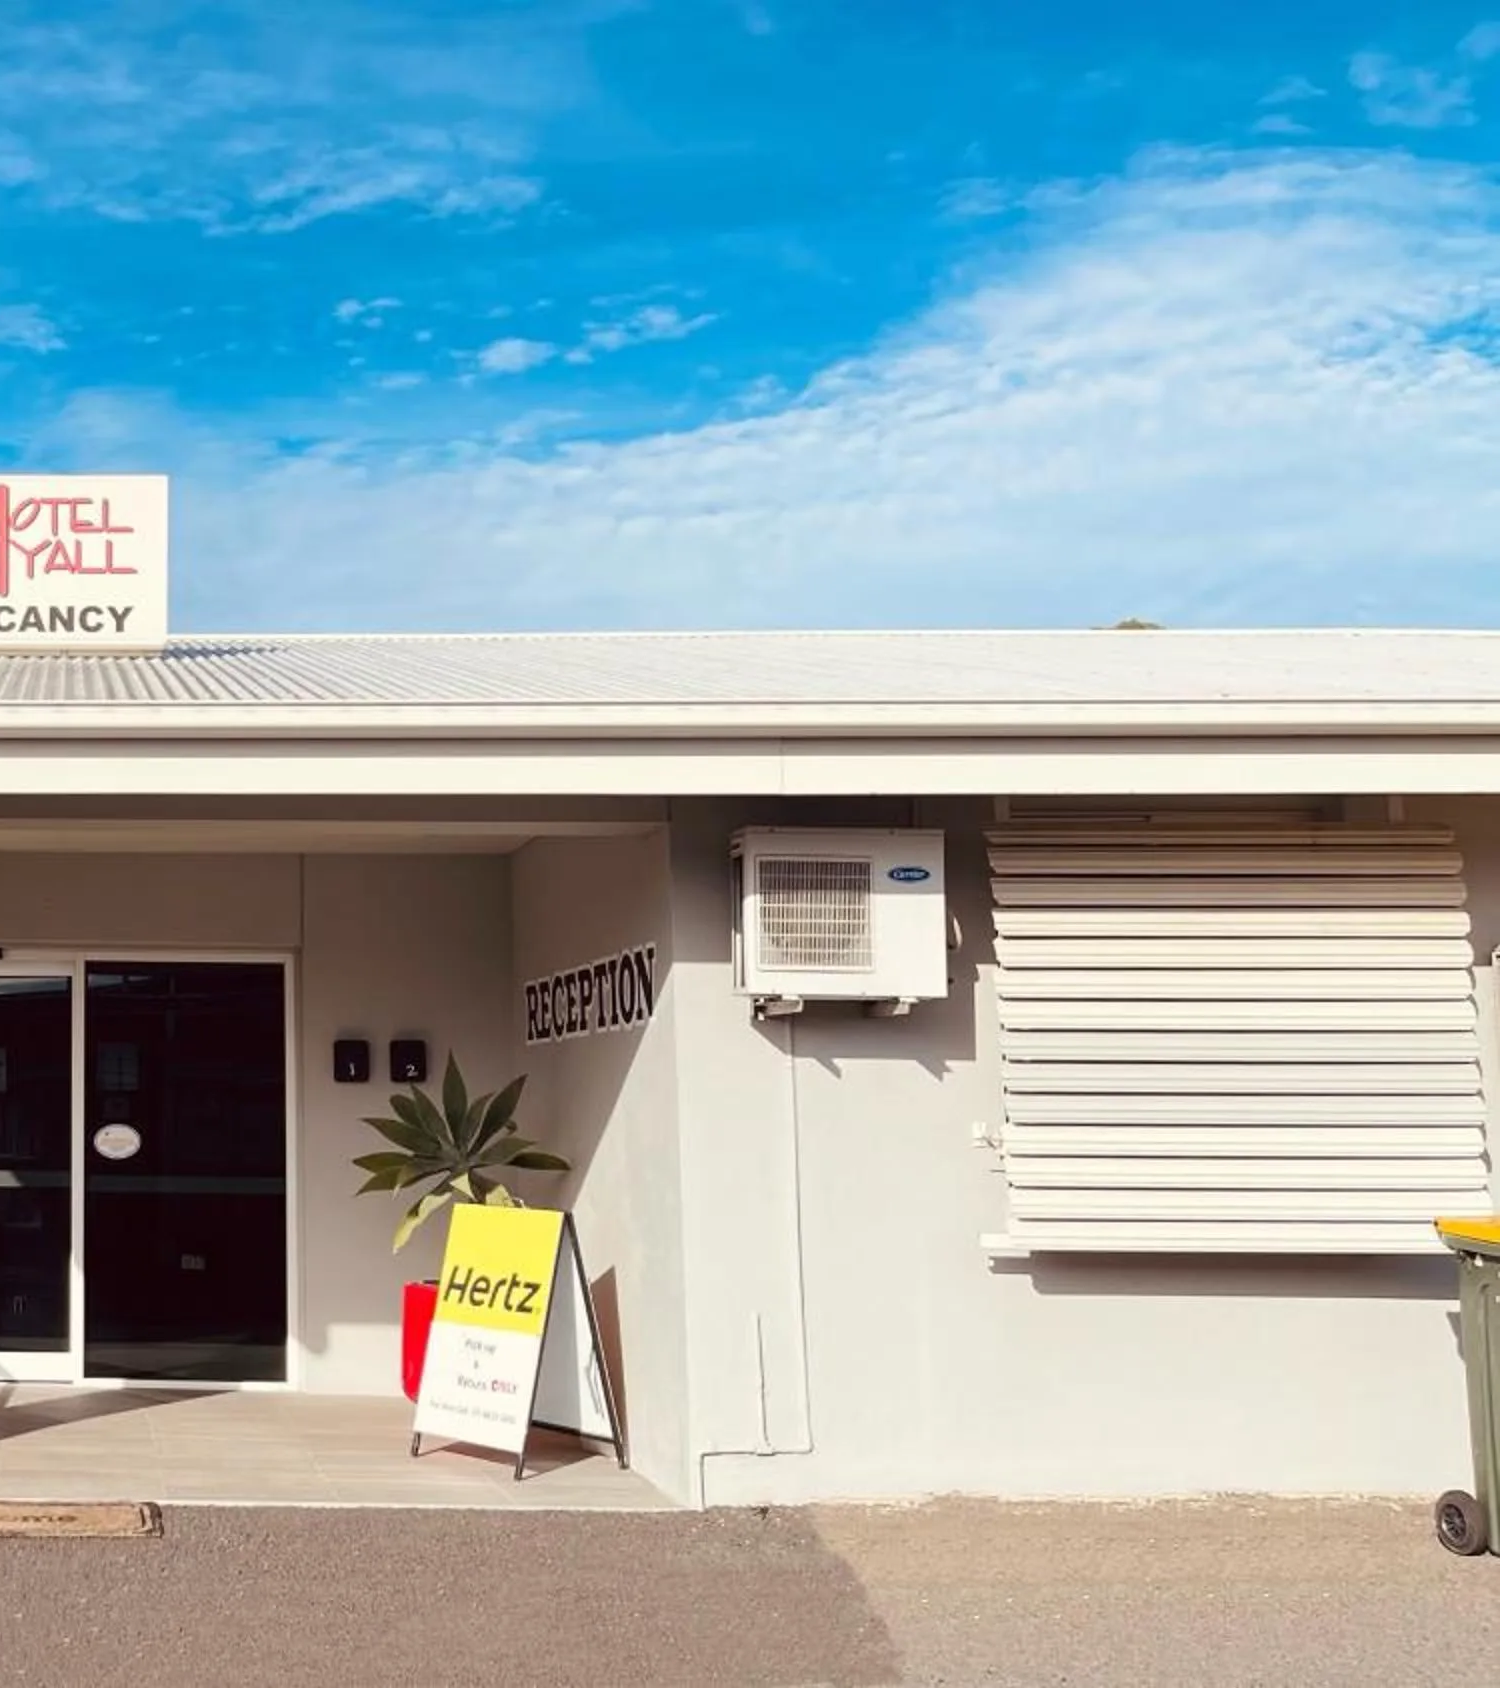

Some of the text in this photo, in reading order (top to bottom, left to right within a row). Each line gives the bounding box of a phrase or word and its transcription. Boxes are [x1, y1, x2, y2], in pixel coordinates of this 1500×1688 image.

[525, 945, 657, 1042] RECEPTION
[349, 1062, 356, 1076] 1
[405, 1064, 419, 1077] 2
[443, 1265, 541, 1313] Hertz
